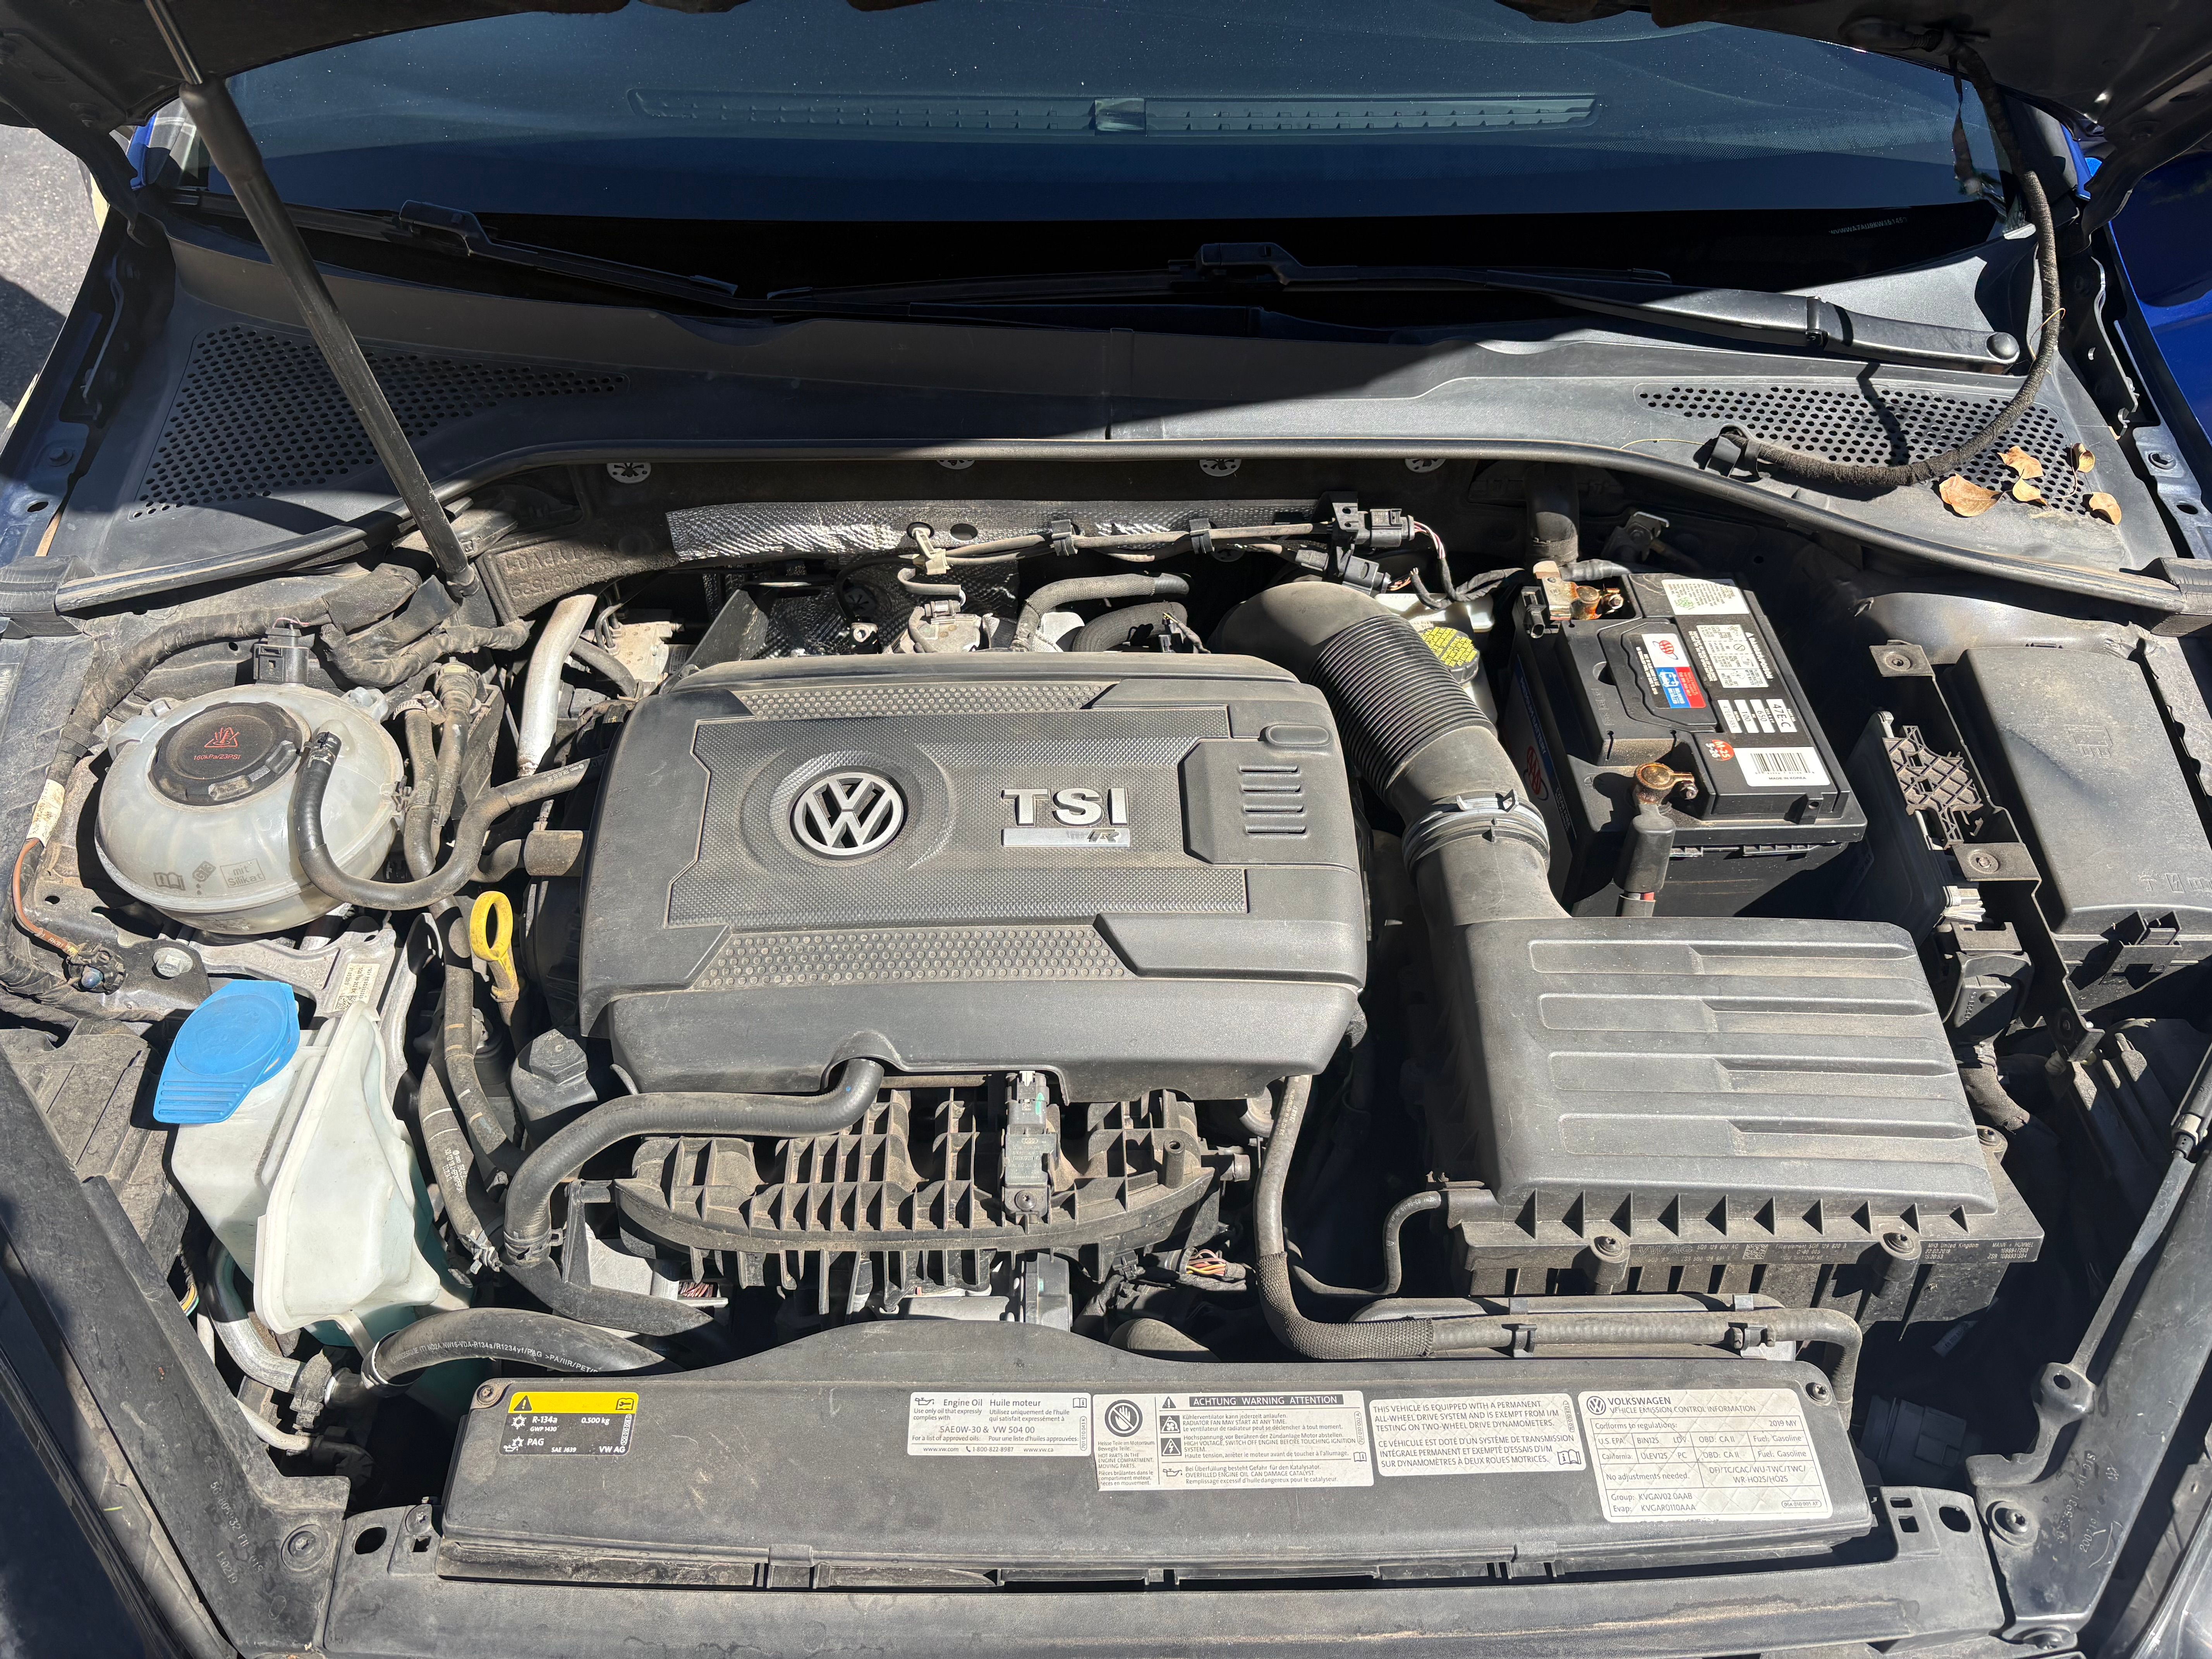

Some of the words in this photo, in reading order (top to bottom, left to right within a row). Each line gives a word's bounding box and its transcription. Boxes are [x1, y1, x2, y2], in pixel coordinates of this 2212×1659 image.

[1741, 711, 1751, 721] 100
[1757, 711, 1767, 721] 650
[1772, 704, 1791, 727] 47E-C
[1529, 718, 1546, 755] BATTERY
[1705, 742, 1721, 758] 5-26
[1715, 741, 1730, 758] M-25
[1002, 787, 1130, 828] TSI
[793, 770, 904, 857] VW
[194, 863, 213, 880] G13
[233, 865, 249, 876] mit
[228, 873, 263, 886] Silikat
[1638, 1245, 1666, 1255] VW
[1668, 1244, 1693, 1255] AG
[943, 1399, 970, 1408] Engine
[1193, 1397, 1237, 1406] ACHTUNG
[1242, 1396, 1285, 1405] WARNING
[1290, 1395, 1337, 1404] ATTENTION
[1431, 1403, 1467, 1412] EQUIPPED
[1497, 1400, 1541, 1408] PERMANENT
[1587, 1396, 1606, 1415] VW
[1607, 1396, 1671, 1405] VOLKSWAGEN
[532, 1416, 558, 1424] R-134a
[601, 1417, 610, 1425] kg
[1375, 1414, 1415, 1422] ALL-WHEEL
[1495, 1410, 1523, 1419] EXEMPT
[1421, 1422, 1468, 1431] TWO-WHEEL
[1492, 1419, 1554, 1428] DYNAMOMETERS.
[1637, 1422, 1677, 1431] regulations:
[527, 1438, 544, 1446] PAG
[613, 1445, 626, 1453] AG
[1618, 1473, 1661, 1482] adjustments
[1662, 1472, 1690, 1481] needed.
[1611, 1494, 1635, 1502] Group:
[1613, 1505, 1632, 1514] Evap:
[216, 1551, 237, 1584] 130219
